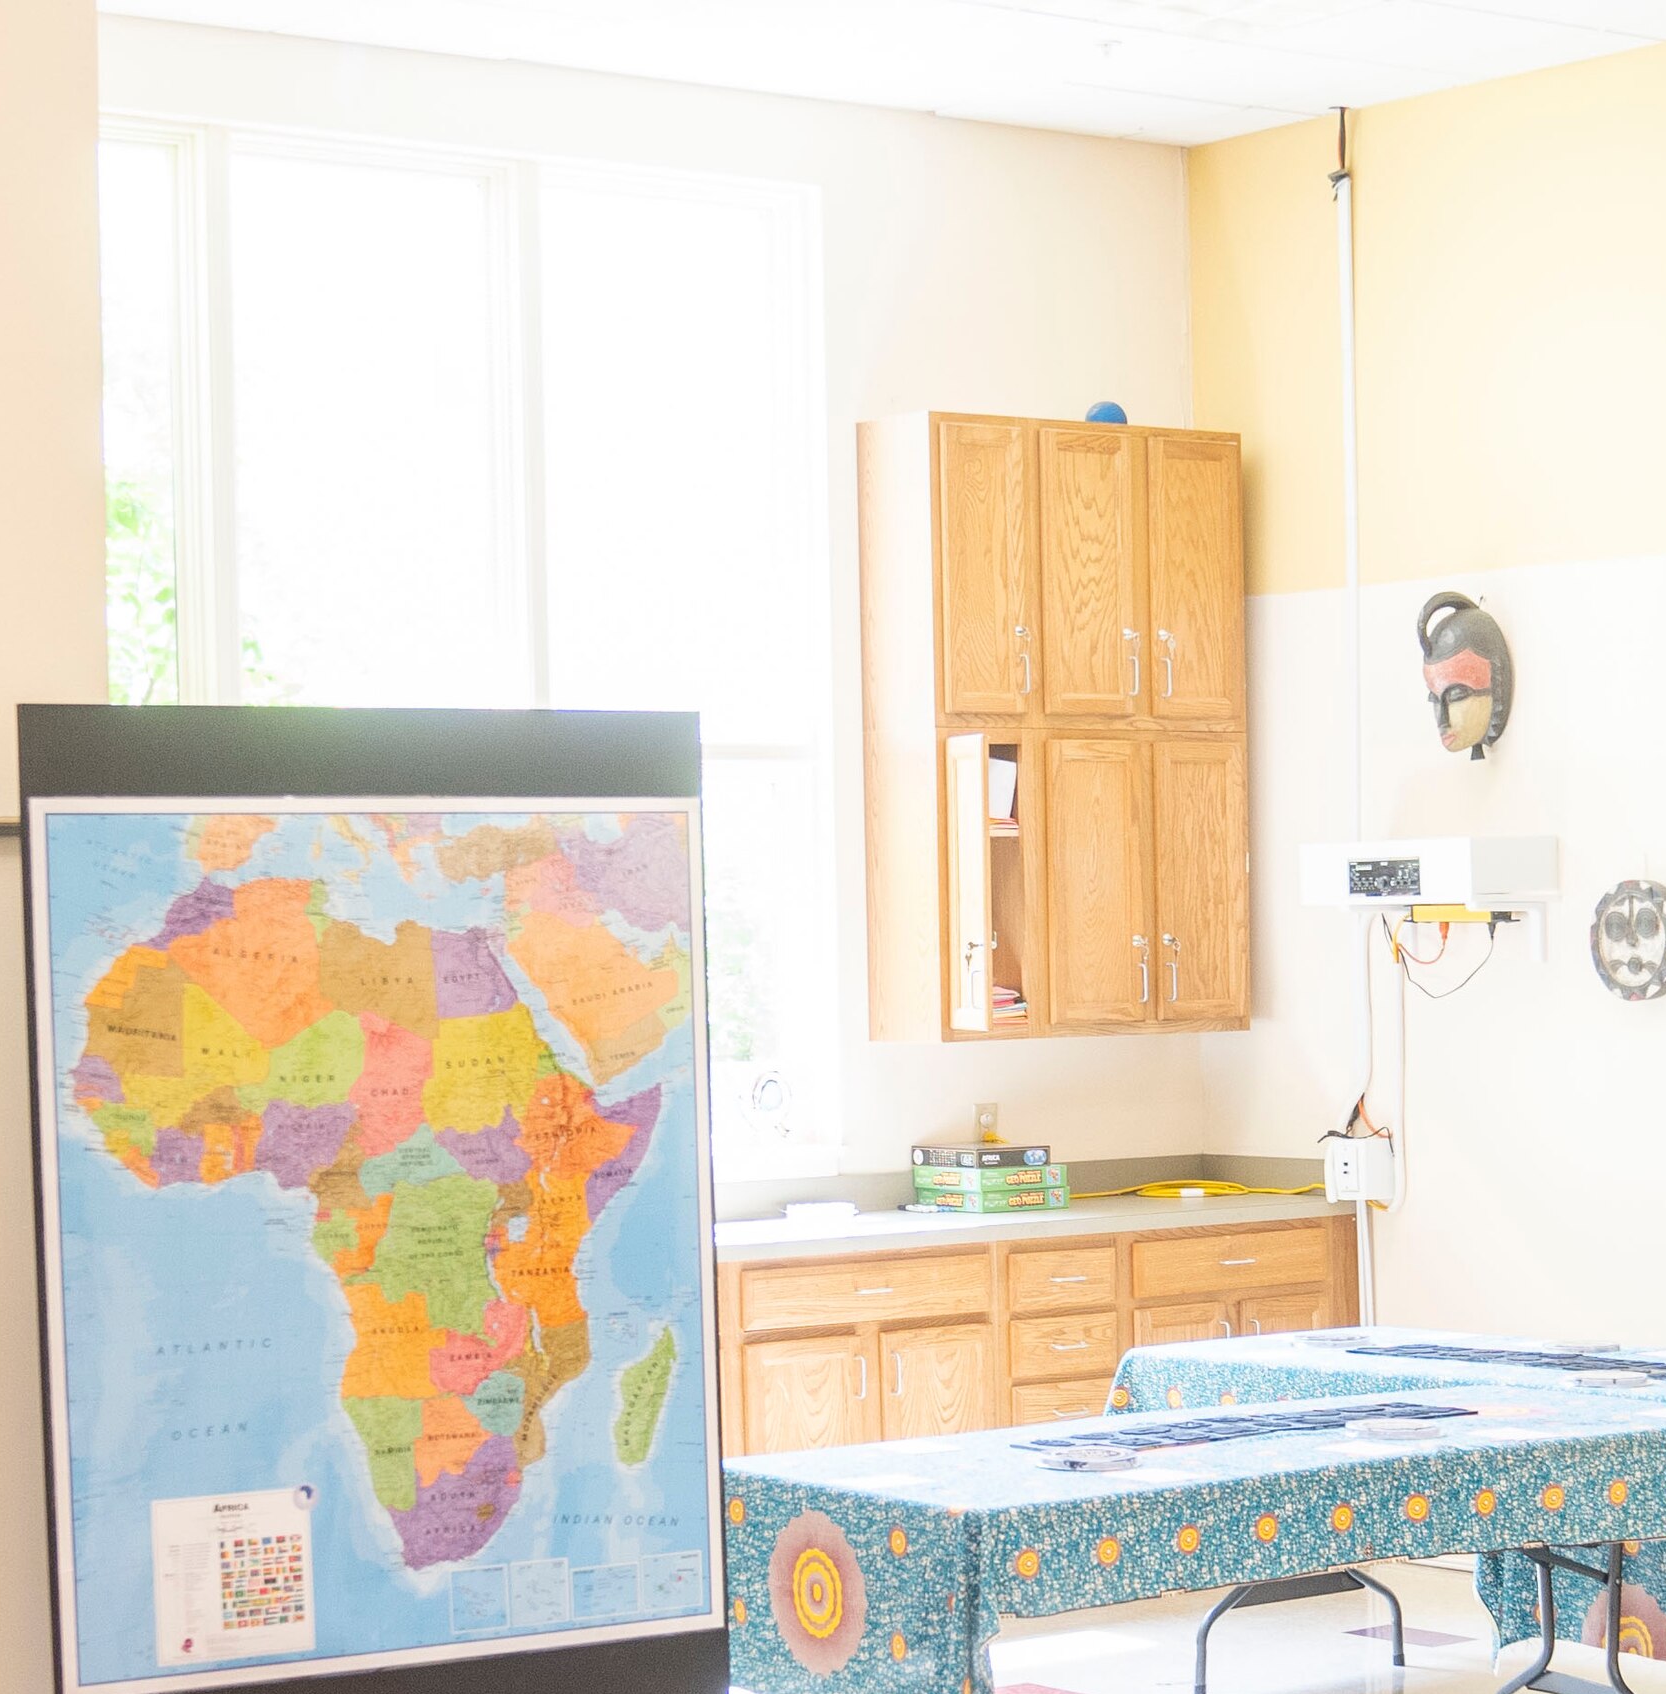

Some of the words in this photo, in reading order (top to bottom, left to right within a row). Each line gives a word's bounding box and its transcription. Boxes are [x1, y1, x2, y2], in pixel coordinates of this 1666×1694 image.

[213, 947, 300, 963] ALGERIA
[360, 977, 414, 986] LIBYA
[443, 972, 481, 984] EGYPT
[612, 981, 654, 996] ARABIA
[445, 1055, 506, 1070] SUDAN
[279, 1075, 336, 1084] NIGER
[370, 1088, 410, 1098] CHAD
[511, 1265, 571, 1278] TANZANIA
[154, 1337, 273, 1357] ATLANTIC
[521, 1374, 559, 1442] MOZAMBIQUE
[623, 1361, 659, 1447] MADAGASCAR
[170, 1420, 249, 1442] OCEAN
[552, 1514, 614, 1525] INDIAN
[623, 1514, 680, 1527] OCEAN
